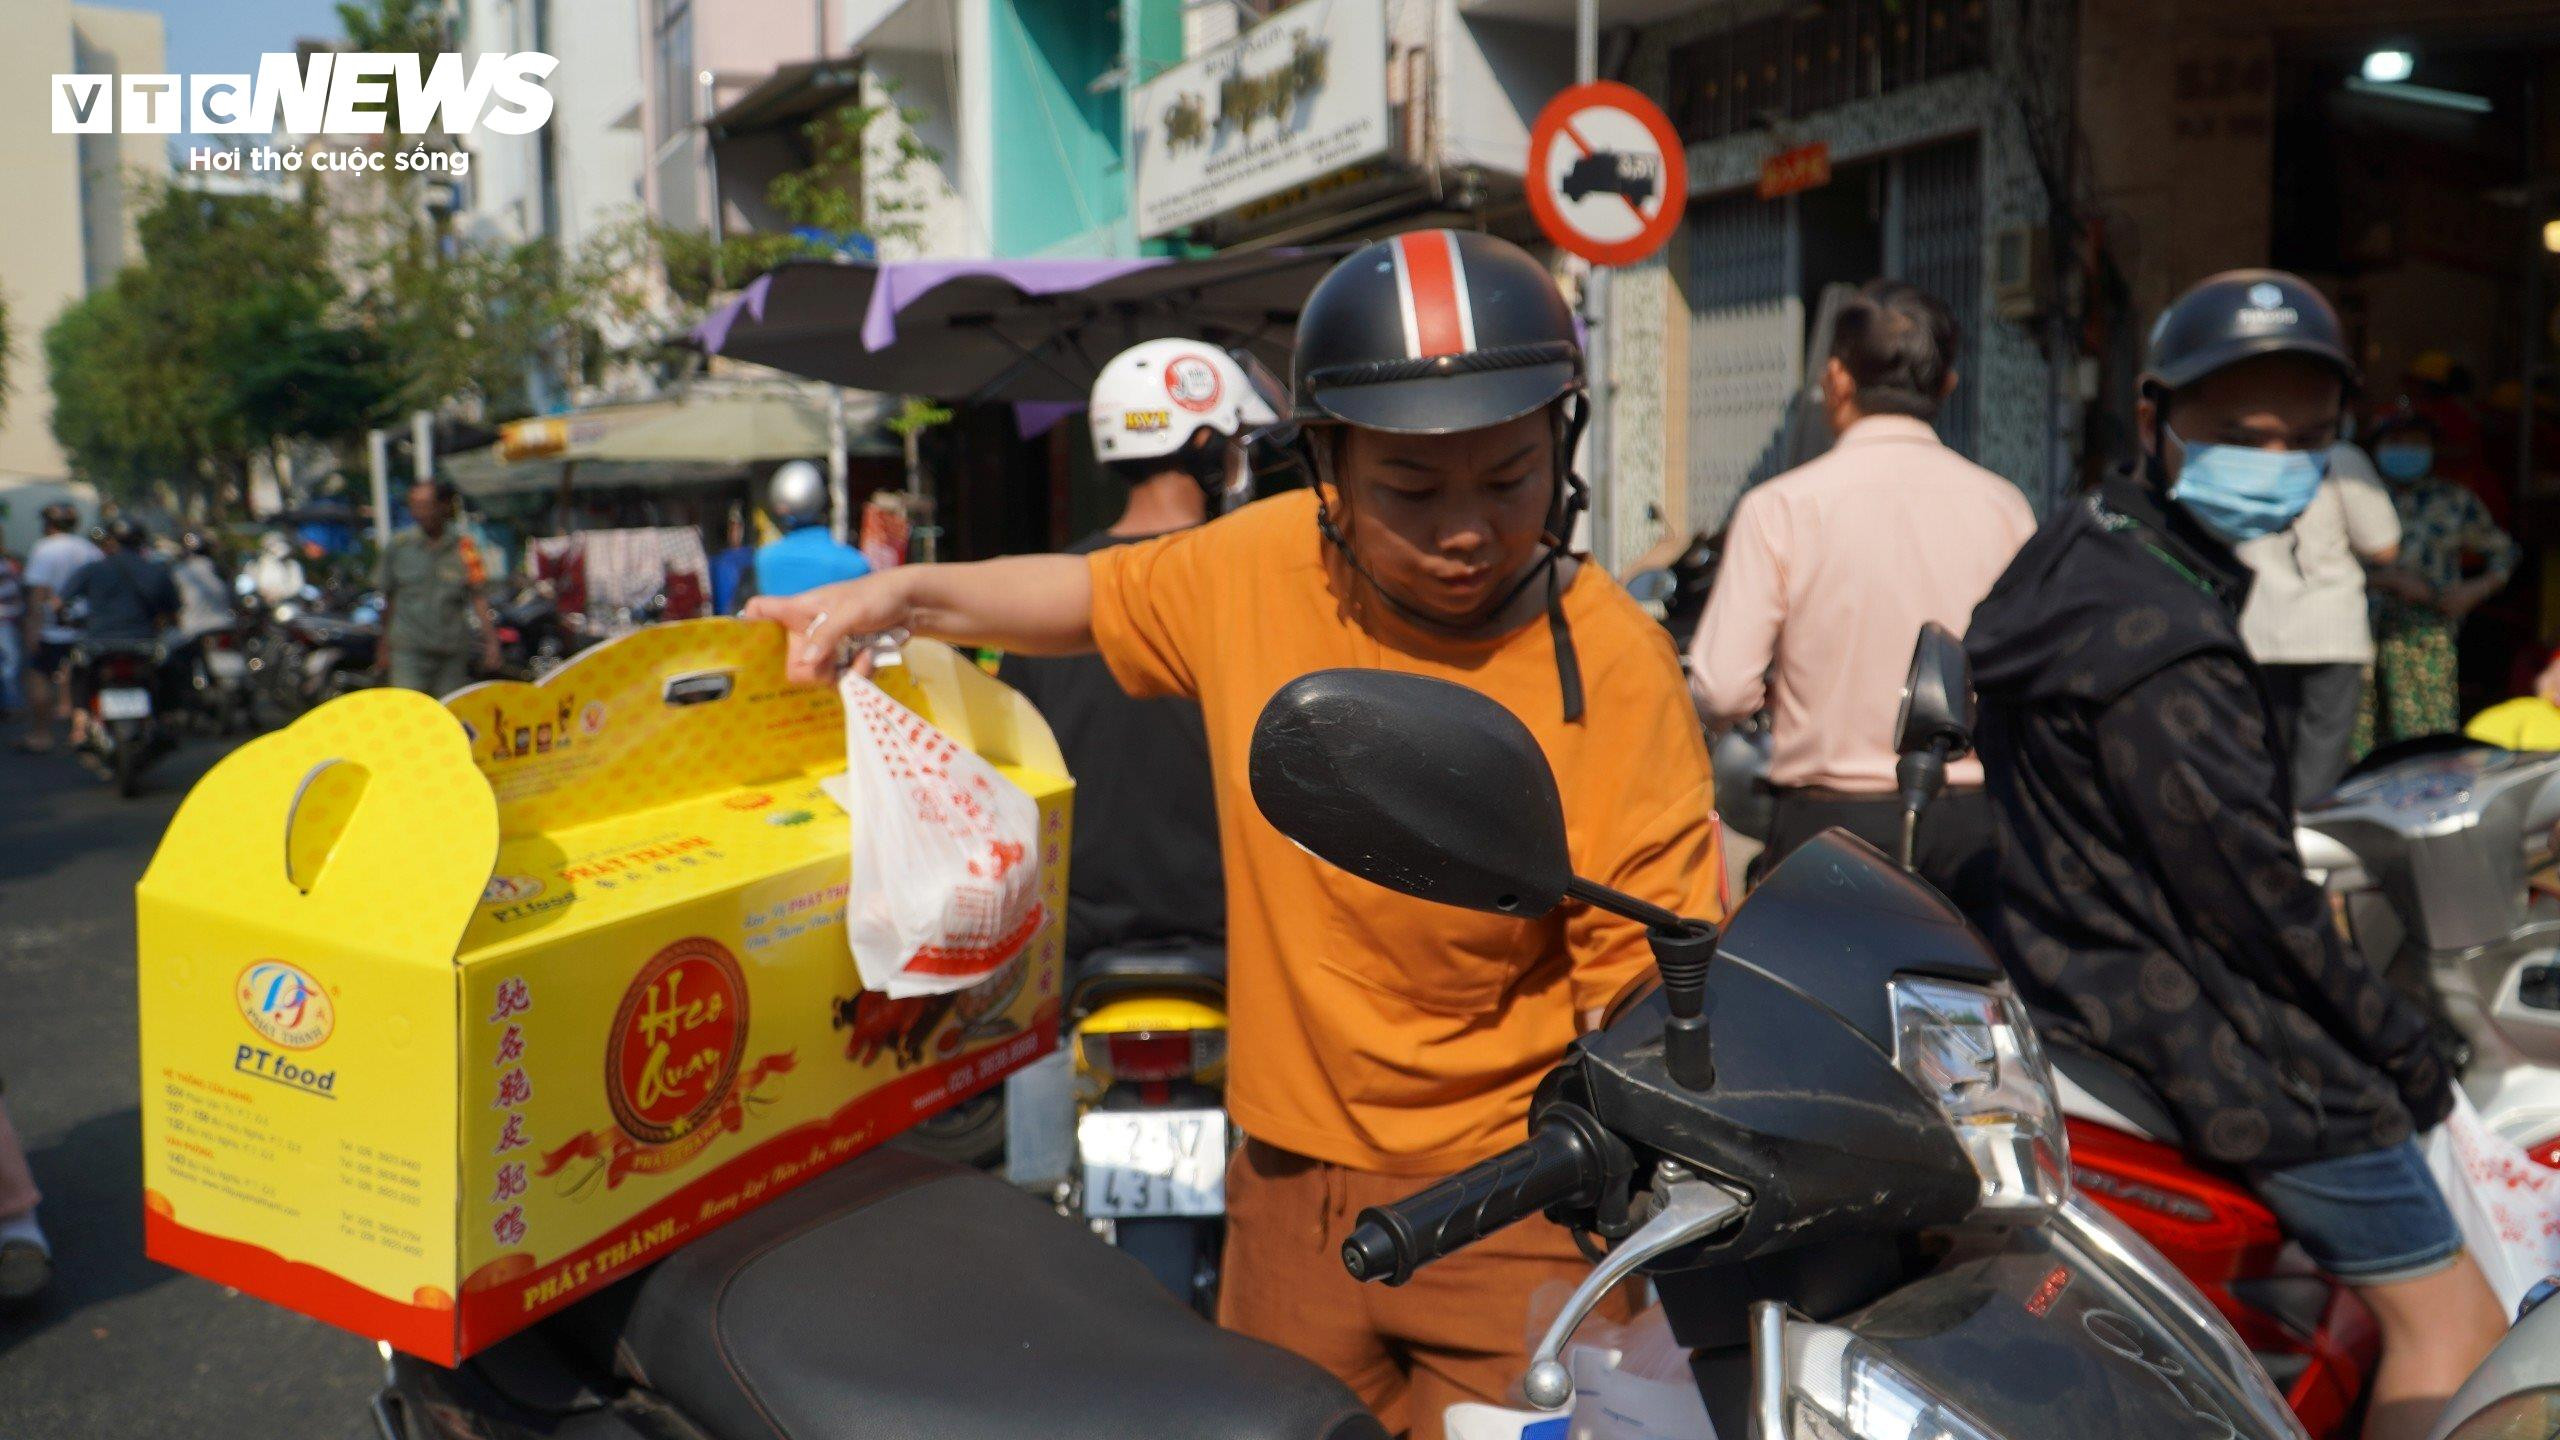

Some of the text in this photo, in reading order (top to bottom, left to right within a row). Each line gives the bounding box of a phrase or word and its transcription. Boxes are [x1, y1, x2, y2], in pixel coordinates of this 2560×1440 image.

[636, 969, 724, 1048] Heo
[274, 1056, 336, 1090] food
[636, 1039, 721, 1111] Quay
[522, 1260, 592, 1312] PHÁT
